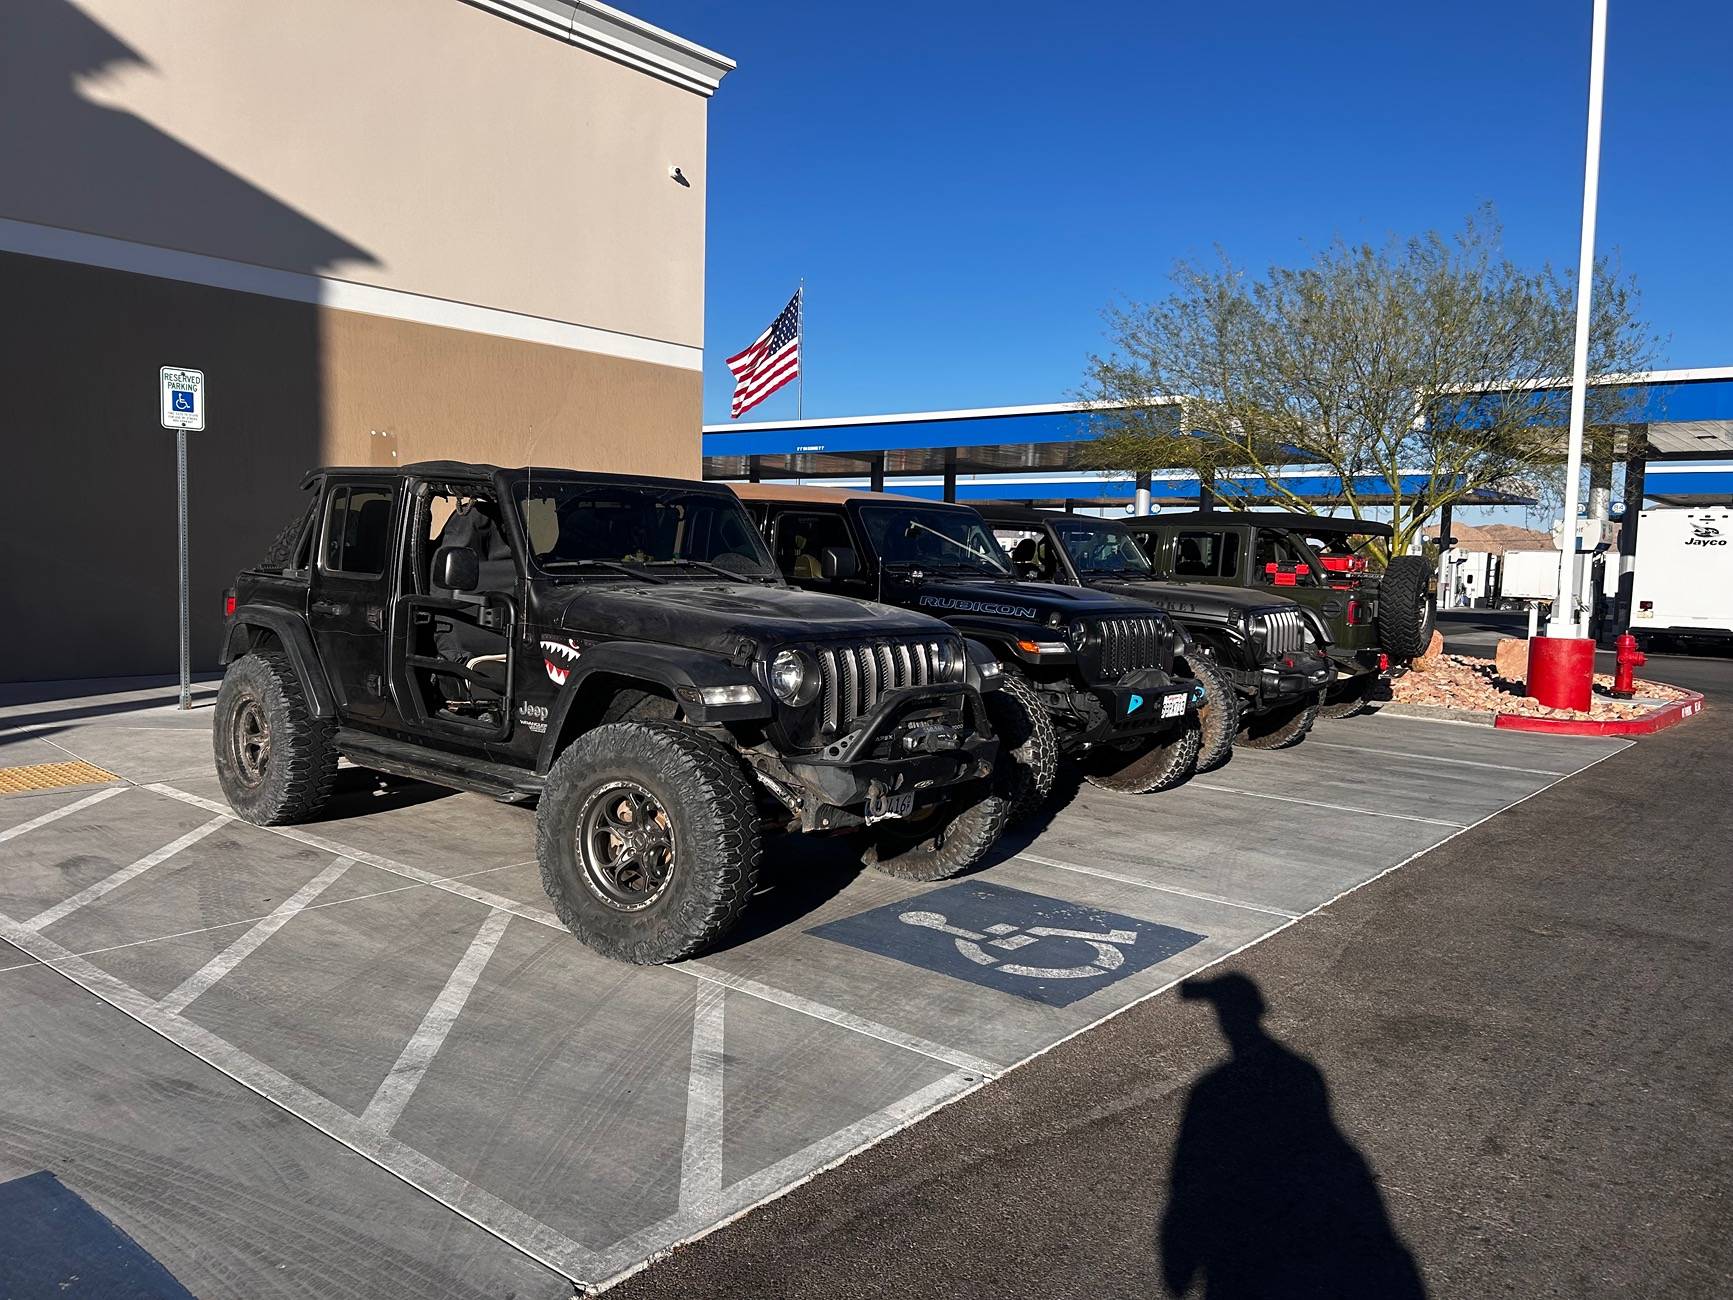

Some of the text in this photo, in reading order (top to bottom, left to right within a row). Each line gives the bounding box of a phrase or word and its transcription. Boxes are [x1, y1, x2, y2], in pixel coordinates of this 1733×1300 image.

[164, 373, 200, 384] RESERVED
[168, 382, 198, 392] PARKING
[1684, 537, 1728, 548] Jayco
[919, 595, 1037, 618] RUBICON
[519, 701, 548, 721] Jeep
